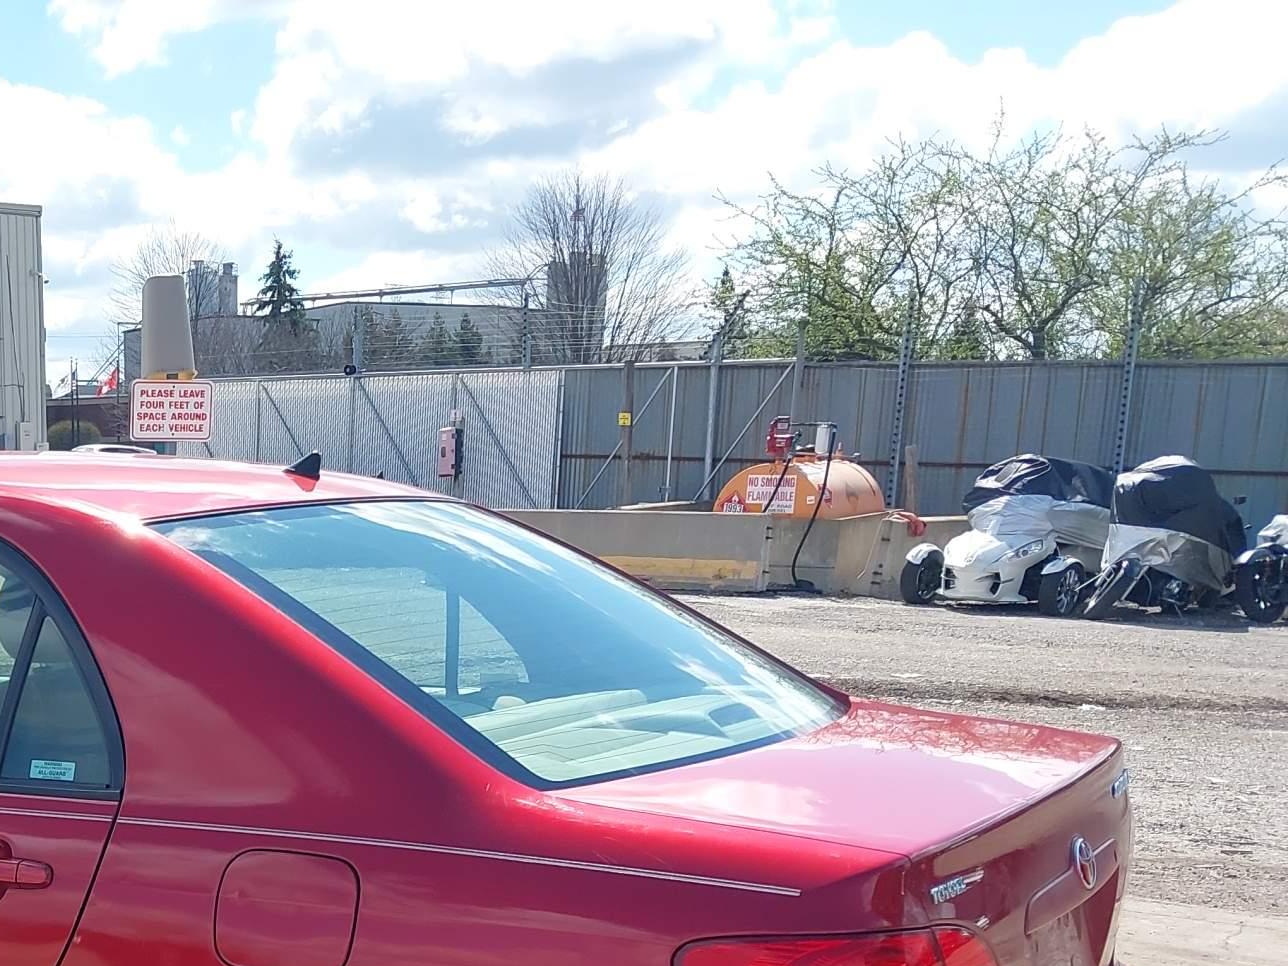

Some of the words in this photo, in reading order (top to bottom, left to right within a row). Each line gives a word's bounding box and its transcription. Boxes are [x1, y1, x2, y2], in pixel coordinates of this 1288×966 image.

[140, 389, 175, 398] PLEASE
[179, 390, 206, 398] LEAVE
[140, 401, 165, 409] FOUR
[169, 401, 190, 409] FEET
[193, 401, 205, 410] OF
[136, 412, 167, 420] SPACE
[171, 412, 208, 421] AROUND
[139, 424, 165, 432] EACH
[168, 424, 204, 432] VEHICLE
[749, 477, 759, 487] NO
[725, 503, 743, 512] 1993
